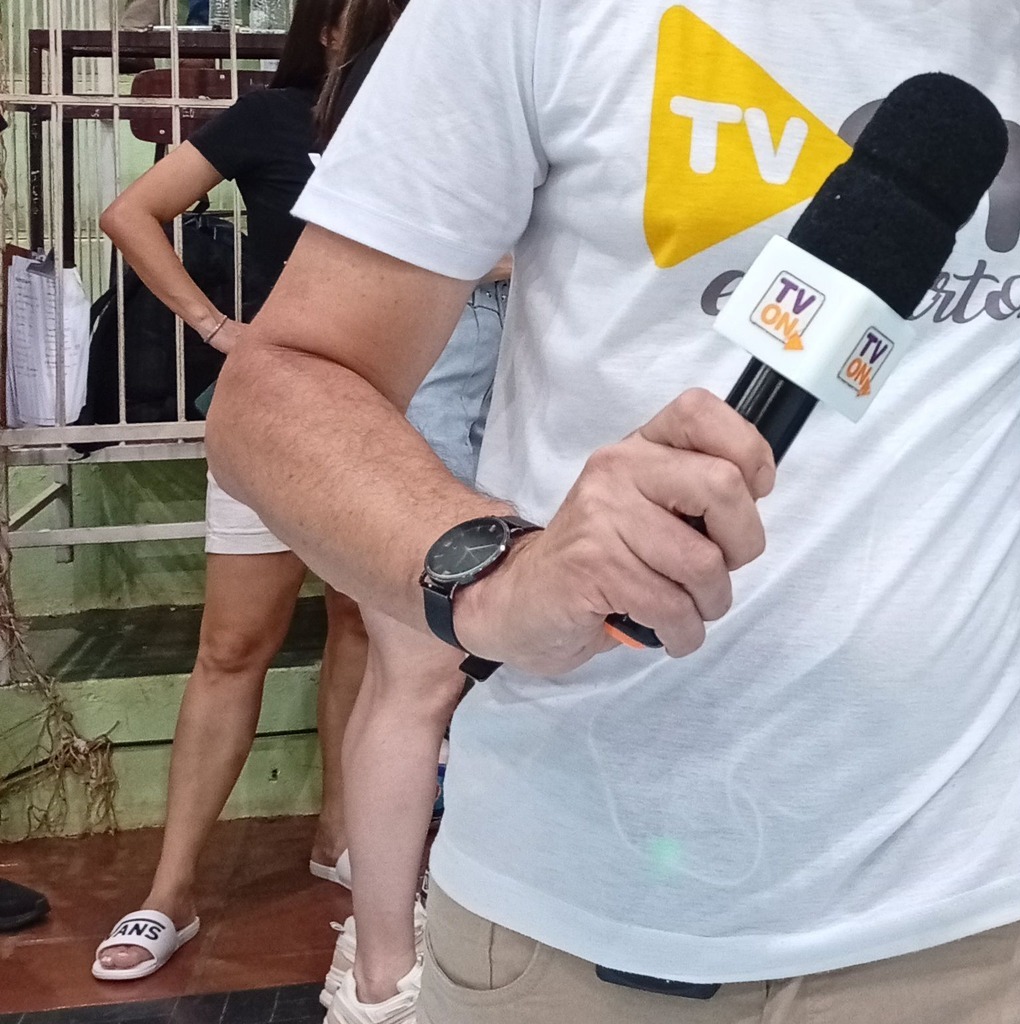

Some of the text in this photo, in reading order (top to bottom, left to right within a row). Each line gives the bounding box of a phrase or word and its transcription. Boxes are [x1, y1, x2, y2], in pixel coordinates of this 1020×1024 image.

[669, 95, 809, 186] TV
[776, 277, 817, 315] TV
[760, 303, 800, 338] ON
[860, 332, 889, 365] TV
[846, 357, 873, 386] ON
